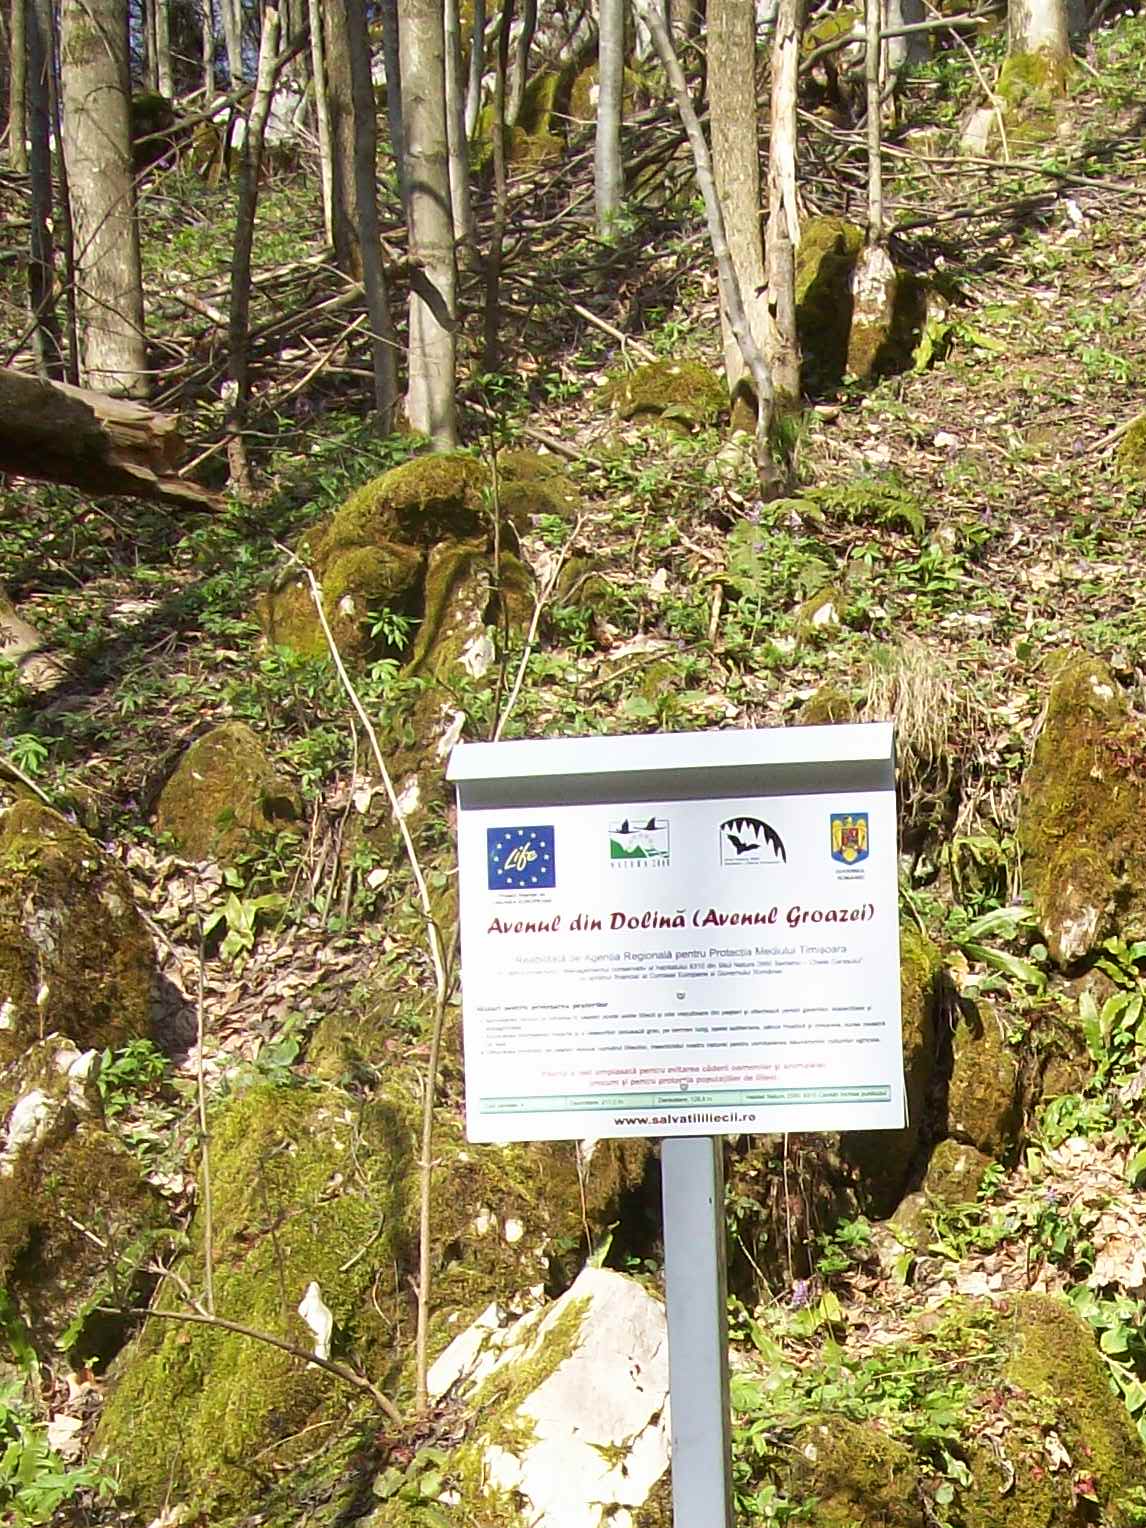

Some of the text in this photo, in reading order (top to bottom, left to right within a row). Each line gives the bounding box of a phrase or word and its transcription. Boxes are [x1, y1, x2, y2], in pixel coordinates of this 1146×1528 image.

[504, 842, 538, 871] Life
[487, 903, 875, 935] Avenul din Dolină (Avenul Groazei)
[675, 949, 706, 960] pentru
[614, 1113, 756, 1126] www.salvatililiecii.ro
